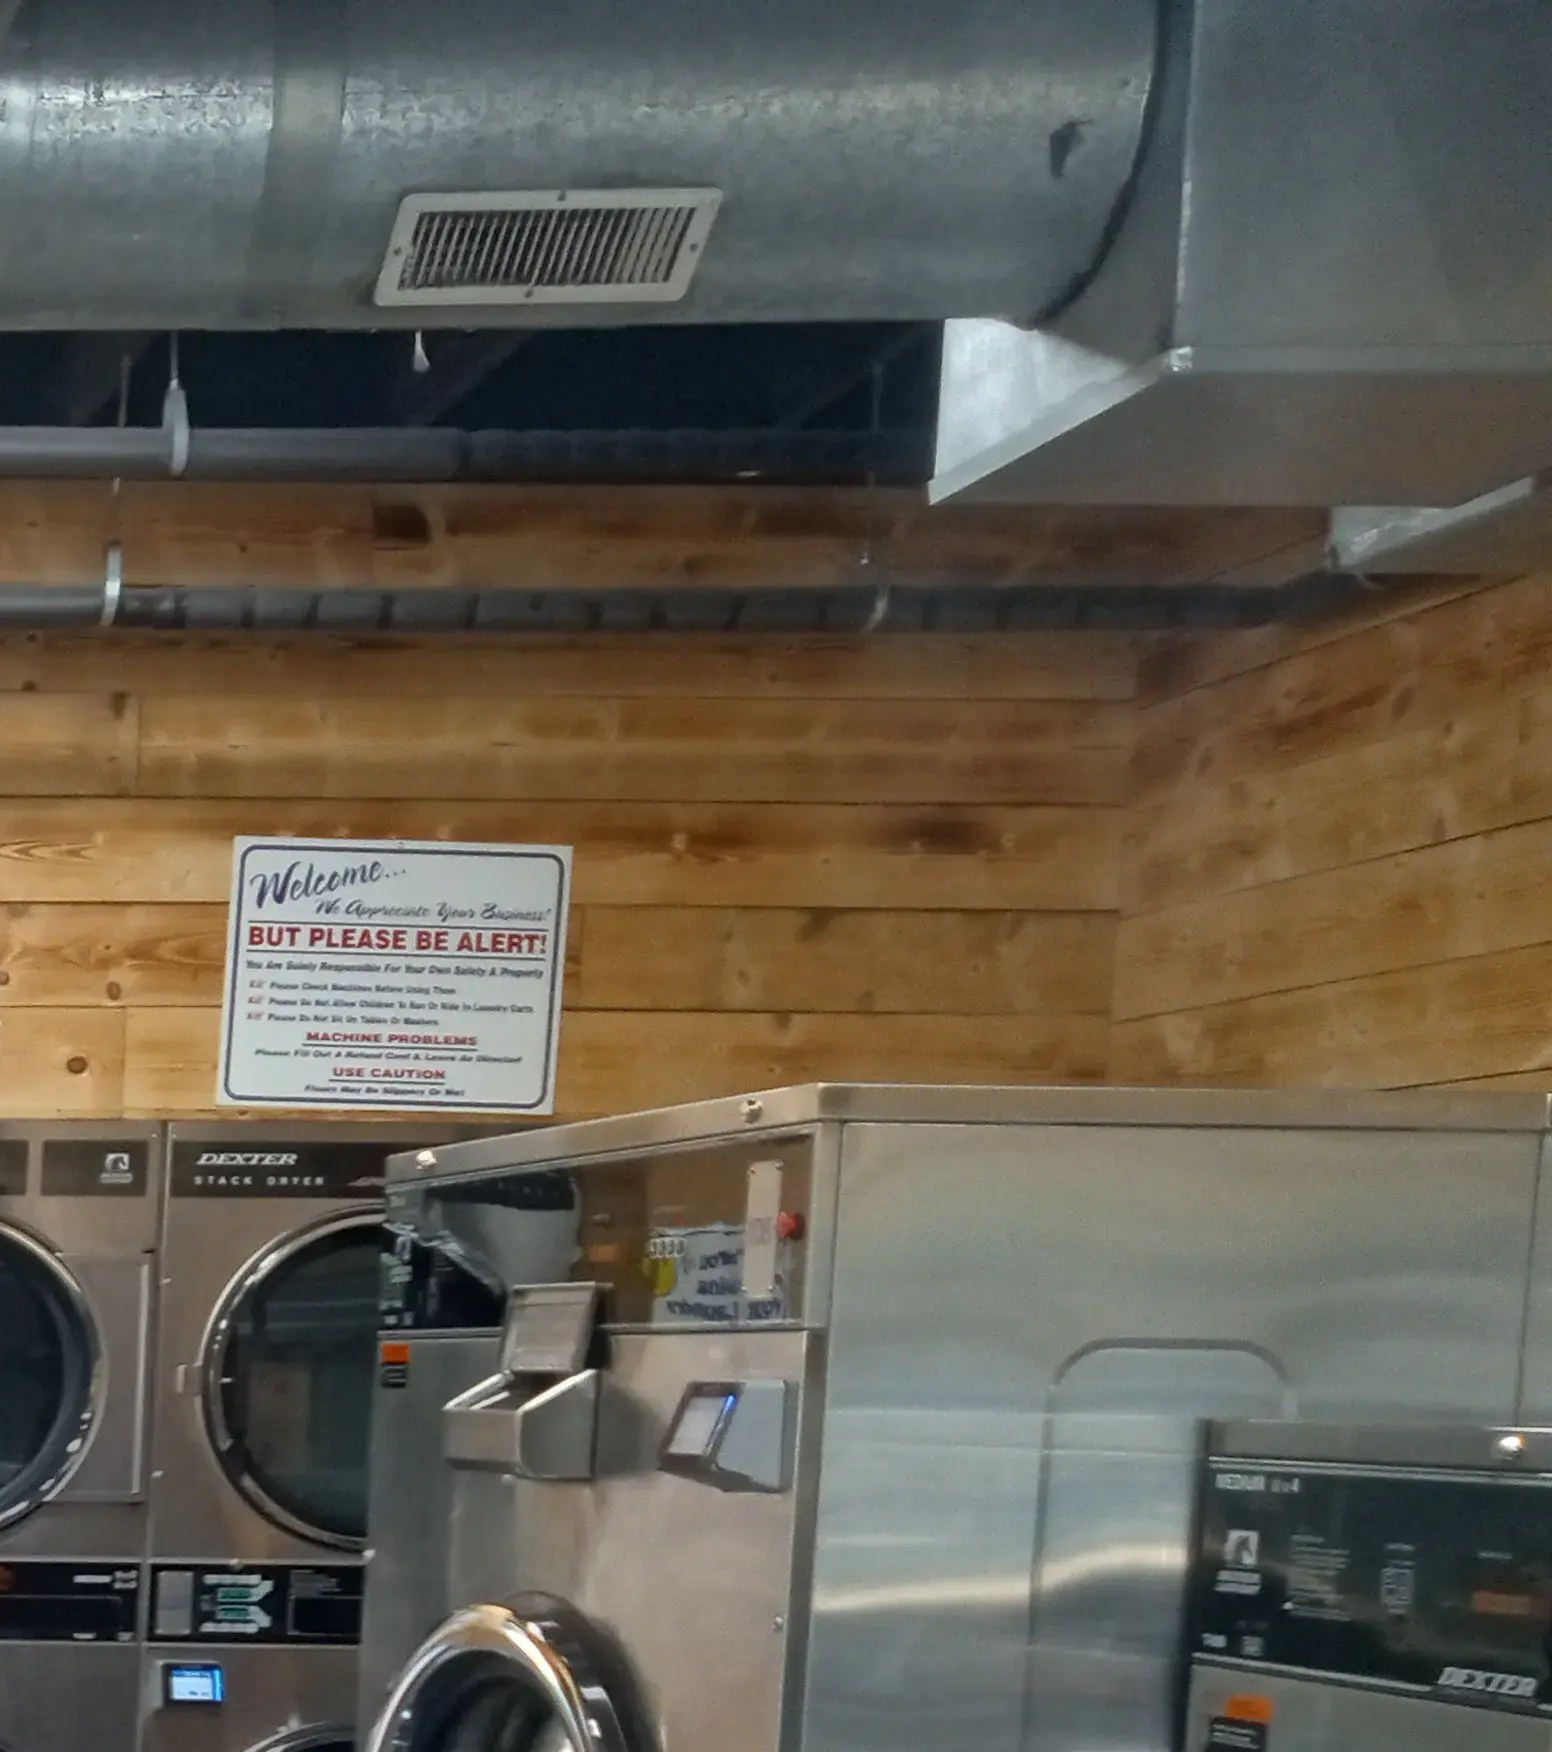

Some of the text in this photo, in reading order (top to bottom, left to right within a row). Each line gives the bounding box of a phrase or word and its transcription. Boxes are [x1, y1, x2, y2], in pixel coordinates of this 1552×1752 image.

[248, 926, 548, 954] BUT PLEASE BE ALERT!
[306, 1031, 478, 1045] MACHINE PROBLEMS
[332, 1067, 445, 1079] USE CAUTION
[195, 1152, 299, 1166] DEXTER
[194, 1175, 325, 1187] STACK DRYER
[1438, 1666, 1539, 1697] DEXTER
